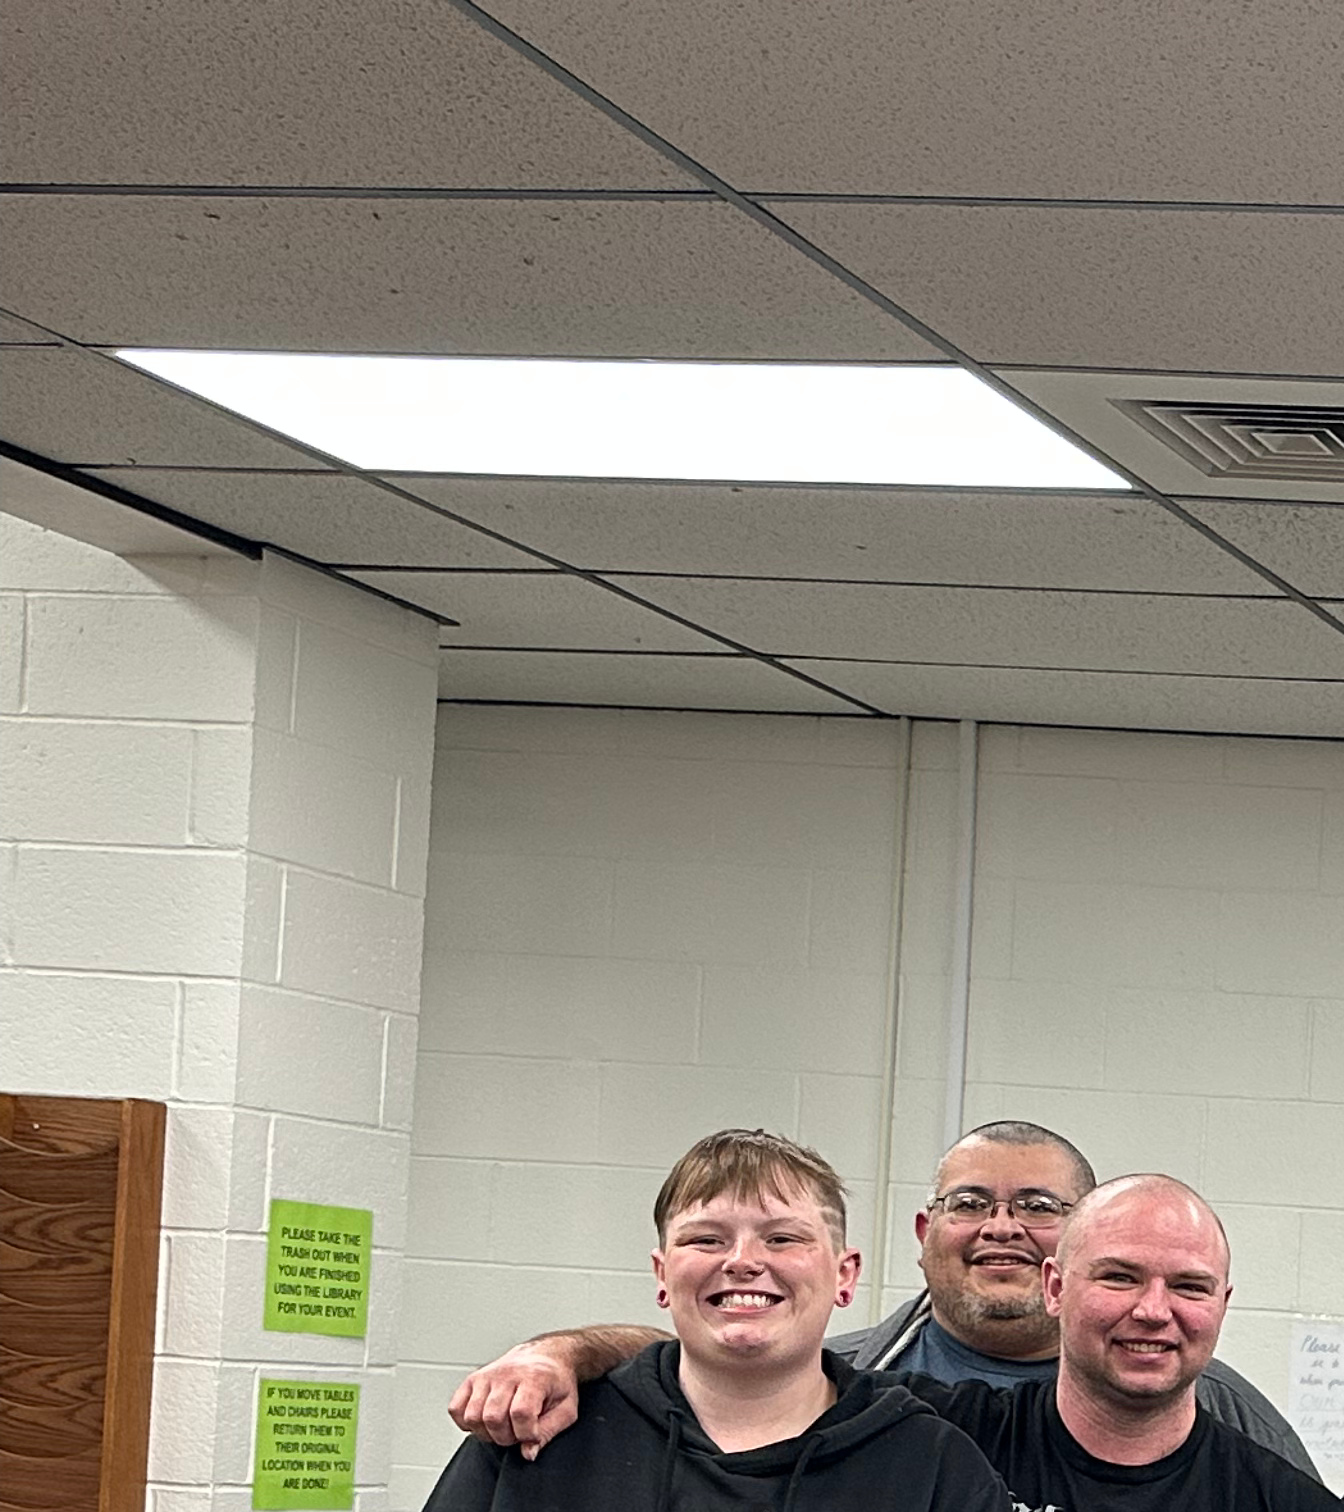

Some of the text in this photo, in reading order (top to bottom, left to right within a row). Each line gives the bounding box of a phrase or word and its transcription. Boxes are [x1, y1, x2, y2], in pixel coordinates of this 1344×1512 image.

[281, 1227, 361, 1246] PLEASE TAKE THE
[281, 1246, 360, 1264] TRASH OUT WHEN
[278, 1264, 361, 1283] YOU ARE FINISHED
[274, 1283, 363, 1300] USING THE LIBRARY
[278, 1302, 356, 1319] FOR YOUR EVENT.
[267, 1387, 354, 1402] IF YOU MOVE TABLES
[267, 1405, 352, 1420] AND CHAIRS PLEASE
[273, 1423, 345, 1437] RETURN THEM TO
[275, 1441, 341, 1454] THEIR ORIGINAL
[262, 1459, 350, 1472] LOCATION WHEN YOU
[282, 1478, 299, 1489] ARE
